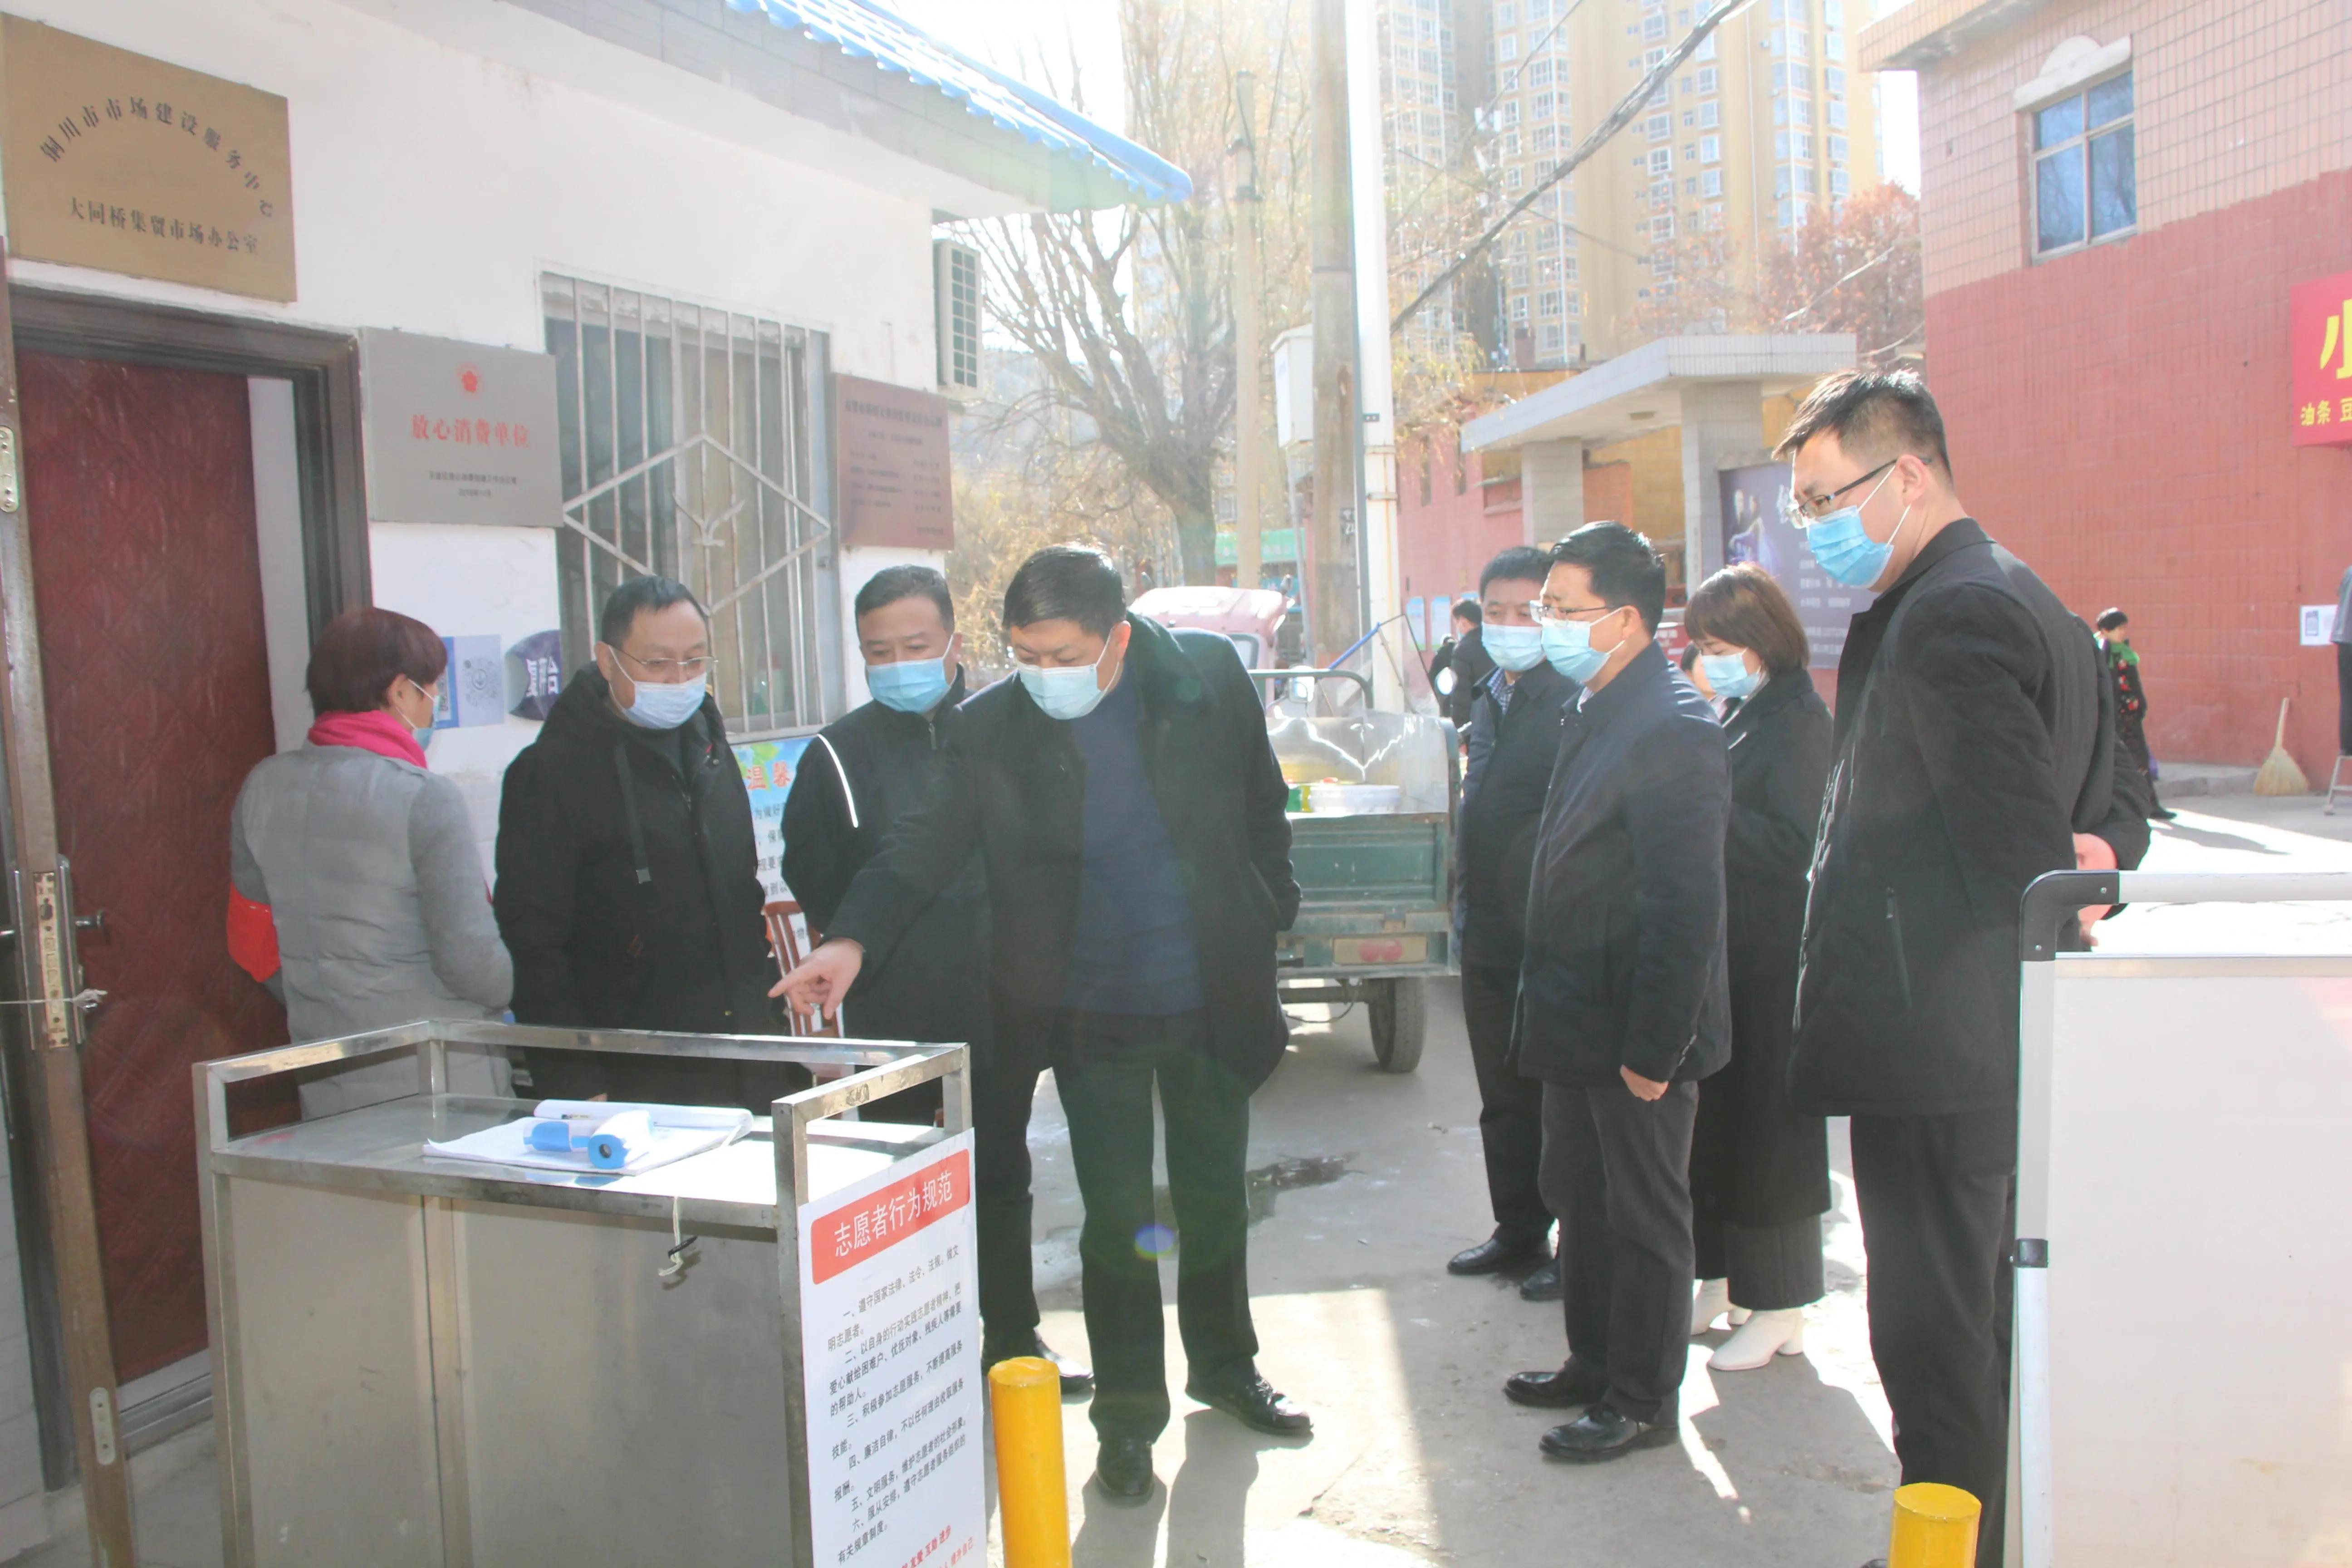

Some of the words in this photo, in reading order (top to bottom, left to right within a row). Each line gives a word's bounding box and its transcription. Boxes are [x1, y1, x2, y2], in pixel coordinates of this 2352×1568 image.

[40, 97, 273, 218] 铜川市市场建设服务中心
[71, 196, 258, 253] 大同桥集贸市场办公室
[2300, 400, 2331, 426] 油条
[412, 414, 530, 448] 放心消费单位
[746, 760, 791, 791] 温馨
[834, 1170, 953, 1257] 志愿者行为规范
[828, 1323, 863, 1352] 明志愿者。
[830, 1387, 866, 1417] 的帮助人。
[832, 1439, 852, 1460] 技能。
[834, 1480, 854, 1503] 报酬。
[838, 1520, 887, 1565] 有关规章制度。
